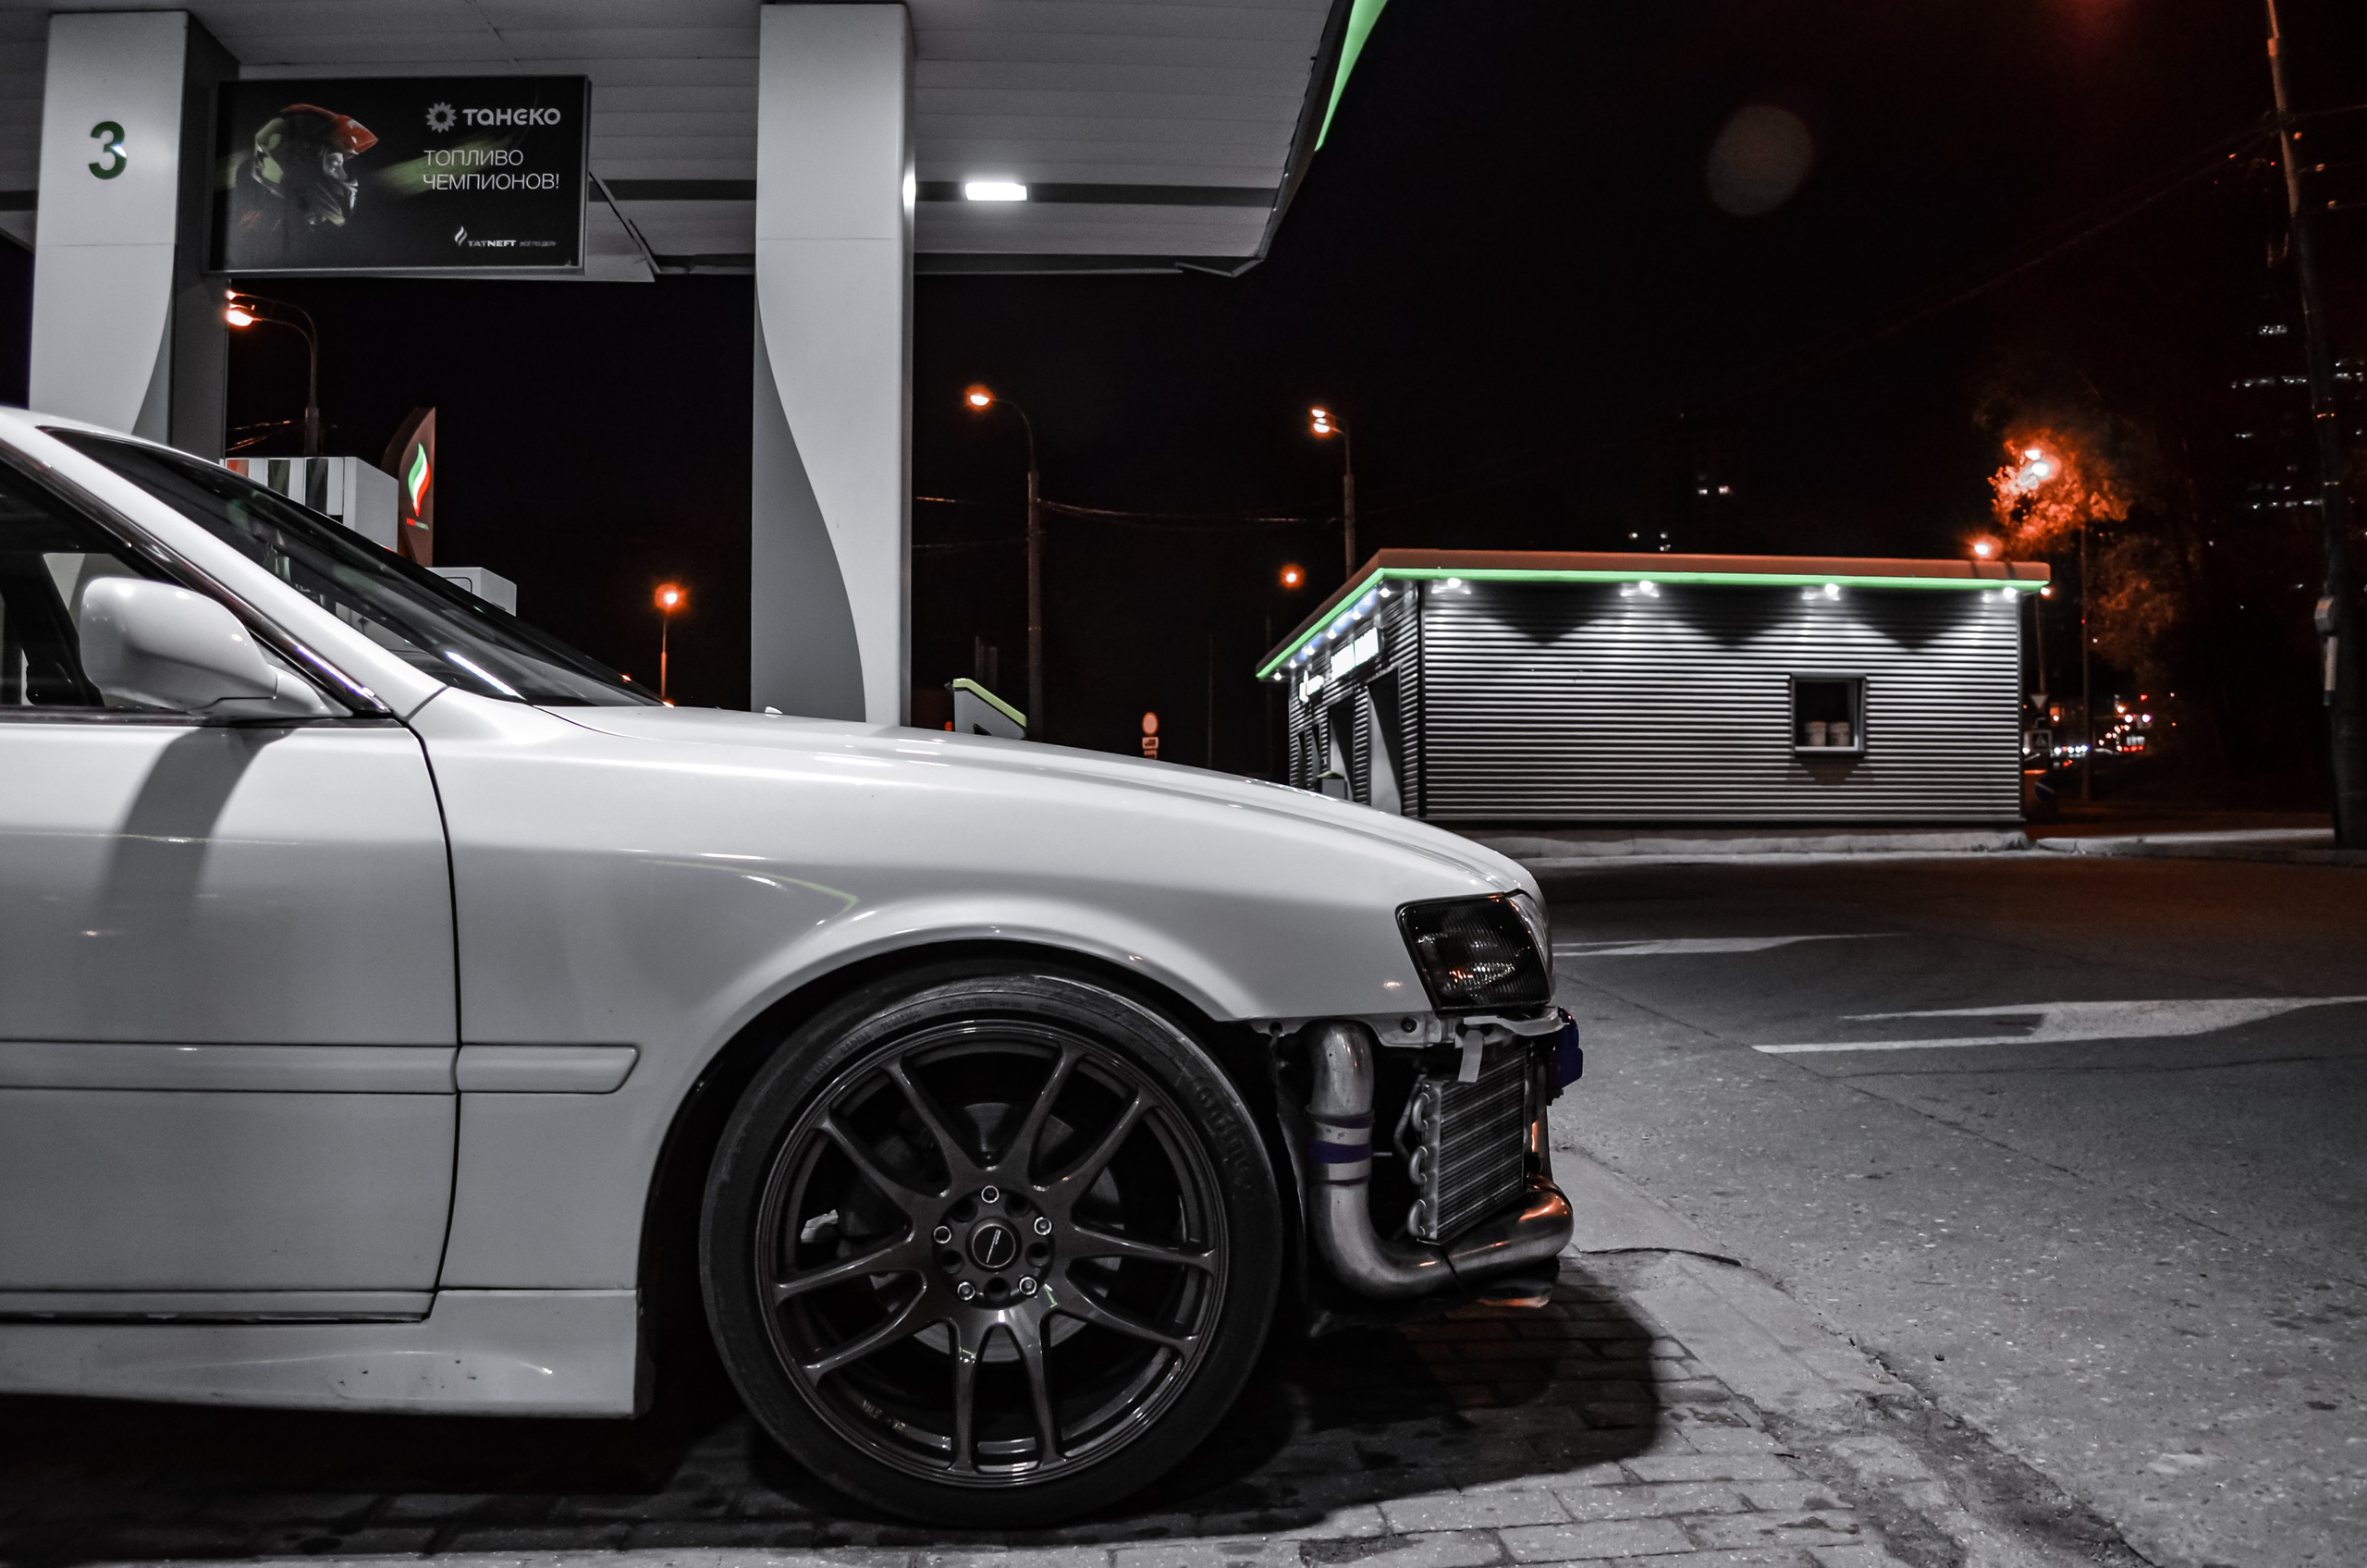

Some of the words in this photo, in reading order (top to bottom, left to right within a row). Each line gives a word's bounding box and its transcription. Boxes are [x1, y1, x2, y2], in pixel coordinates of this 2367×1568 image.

[89, 121, 128, 180] 3
[423, 150, 524, 166] ТОПЛИВО
[423, 173, 559, 190] ЧЕМПИОНОВ!
